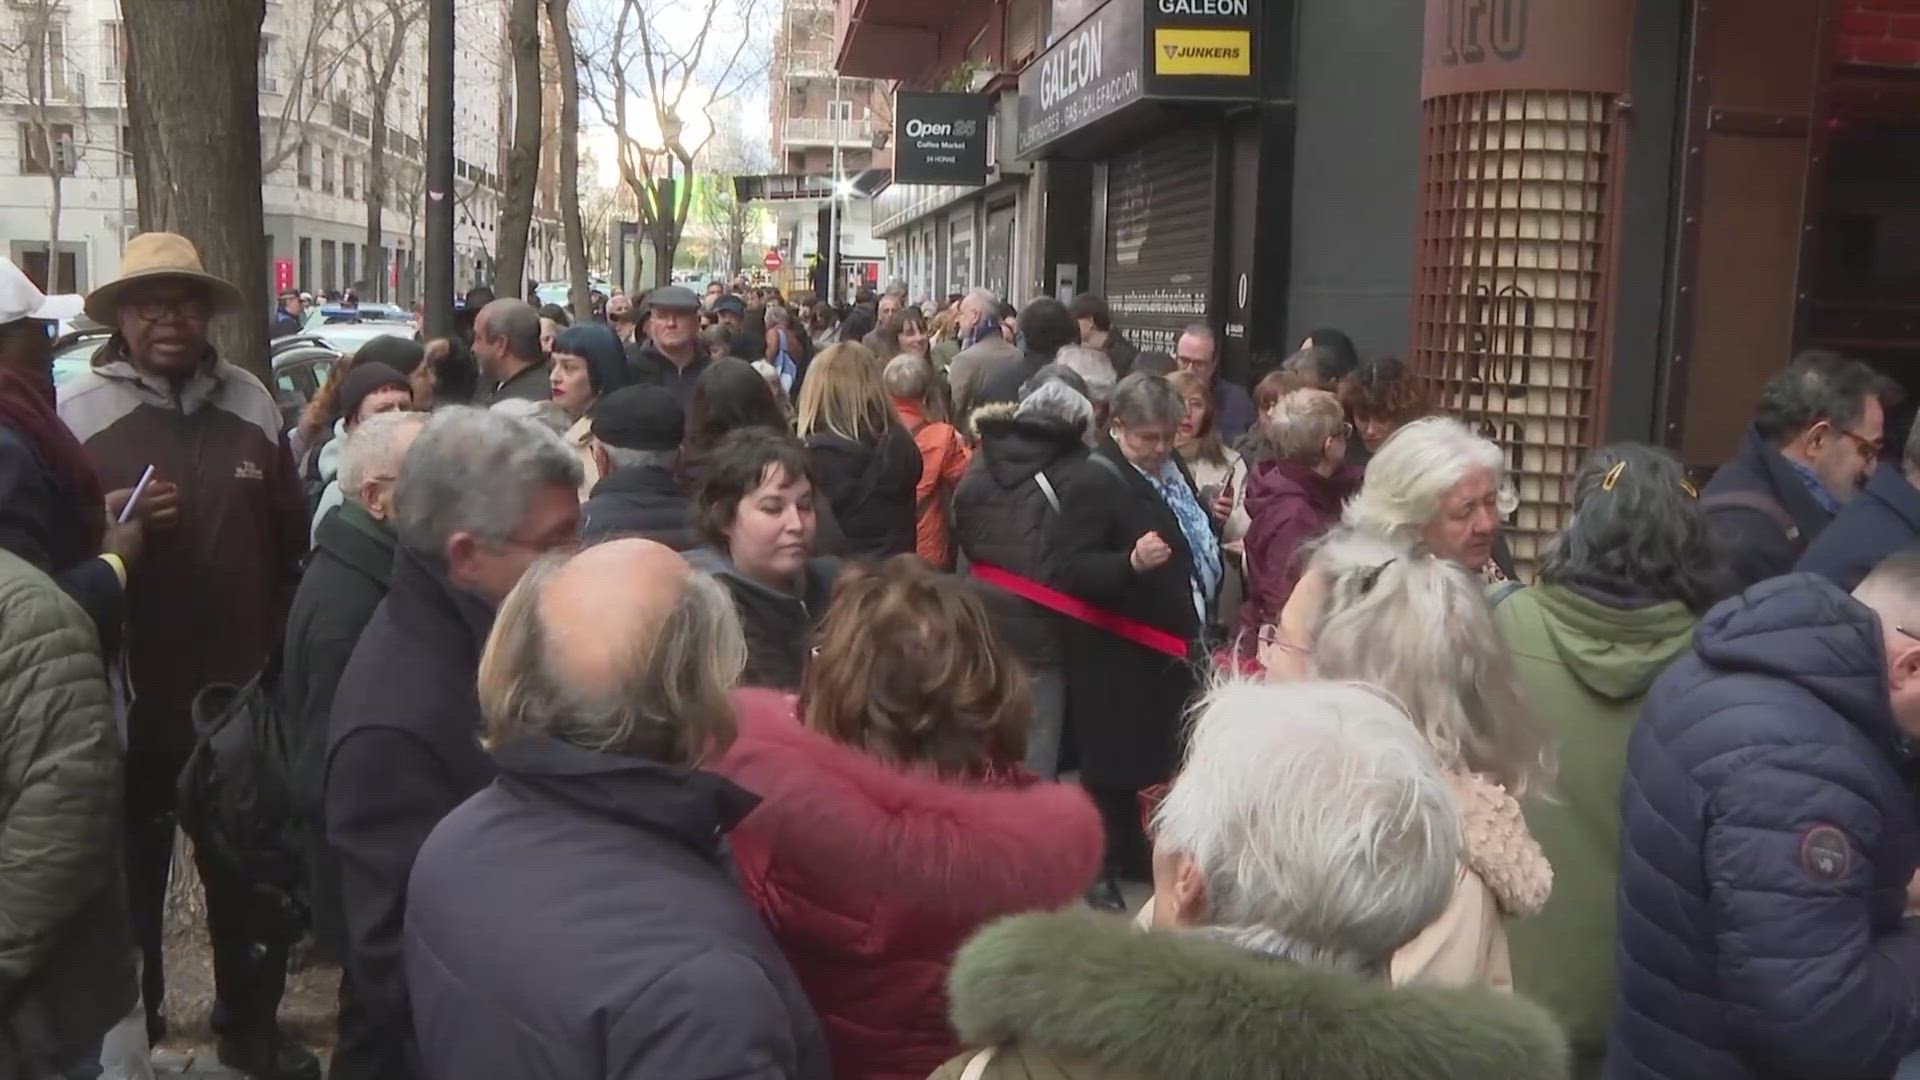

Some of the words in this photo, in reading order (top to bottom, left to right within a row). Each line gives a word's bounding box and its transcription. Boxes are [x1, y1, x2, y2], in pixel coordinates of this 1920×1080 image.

[1040, 20, 1103, 111] GALEON
[1177, 47, 1241, 59] JUNKERS
[1083, 69, 1138, 117] CALEFACCION
[905, 119, 952, 138] Open
